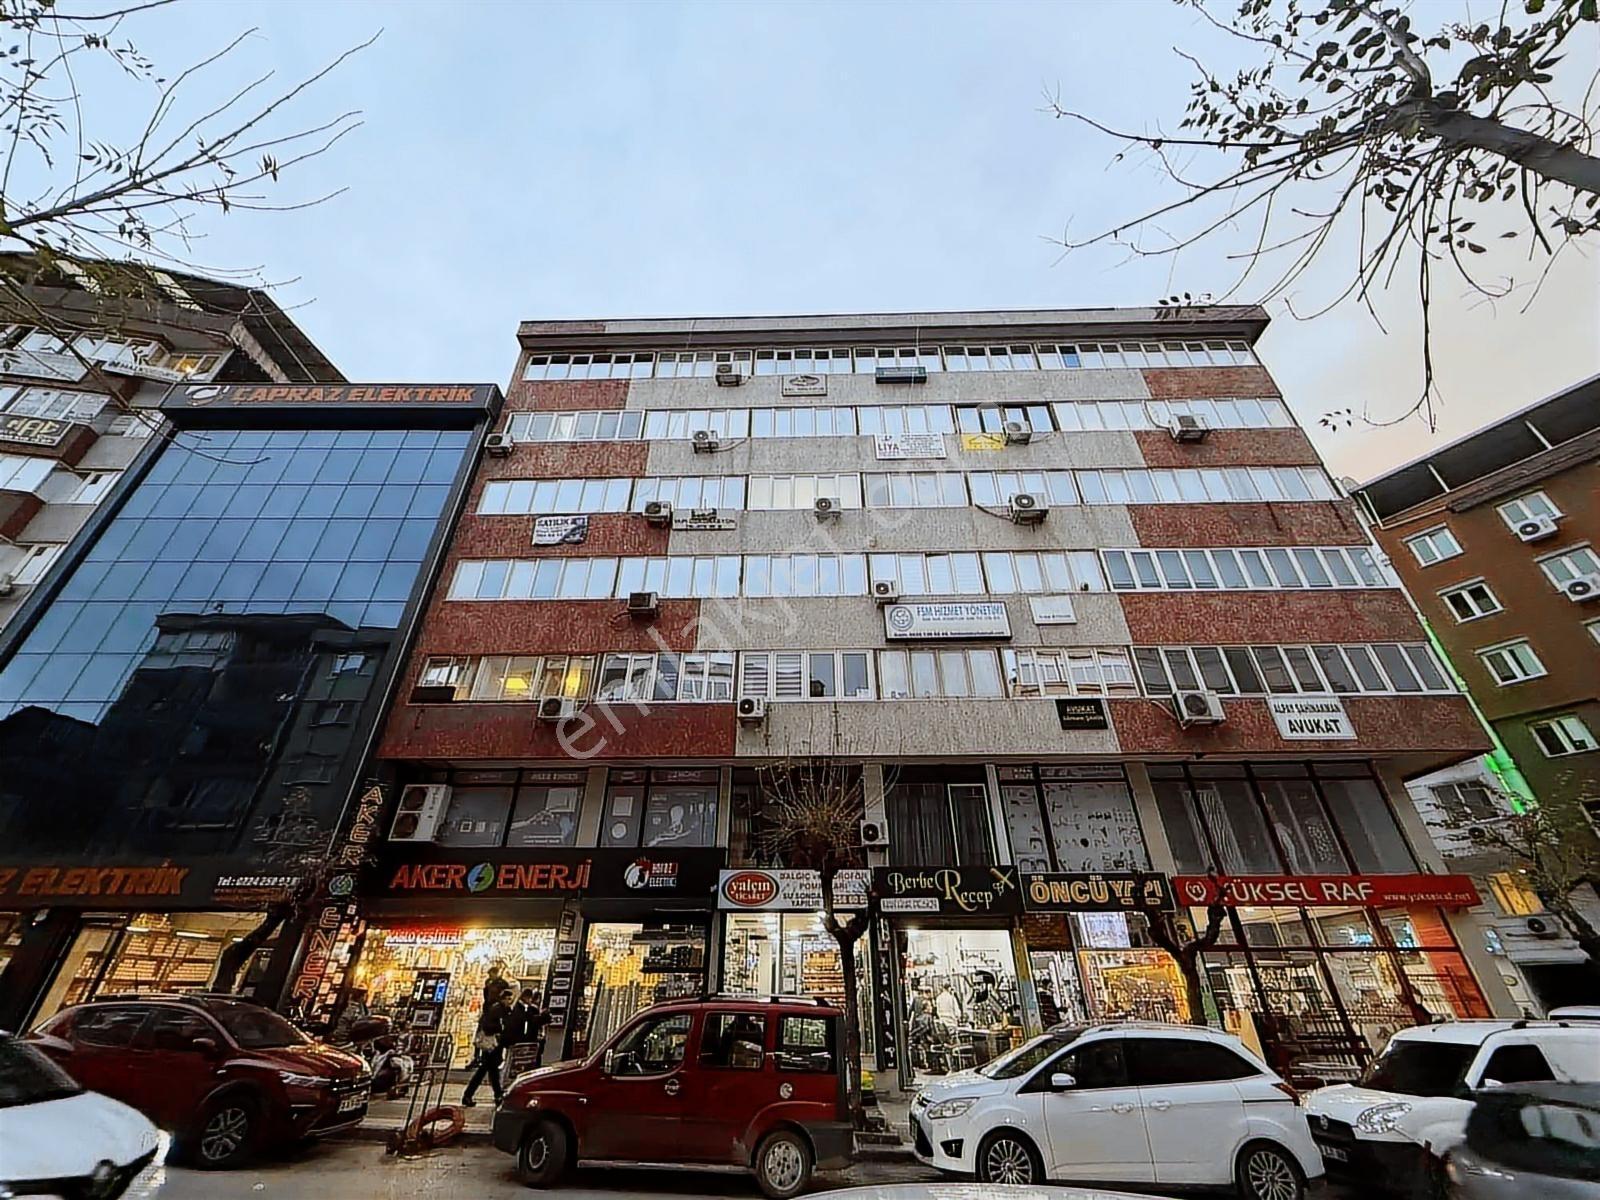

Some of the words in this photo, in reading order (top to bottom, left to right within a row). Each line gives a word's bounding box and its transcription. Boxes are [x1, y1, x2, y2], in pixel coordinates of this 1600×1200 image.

[347, 384, 475, 402] ELEKTRİK
[1288, 719, 1341, 734] AVUKAT
[389, 864, 467, 888] AKER
[497, 859, 592, 889] ENERJİ
[1030, 875, 1109, 904] ÖNCÜ
[1323, 881, 1374, 902] RAF
